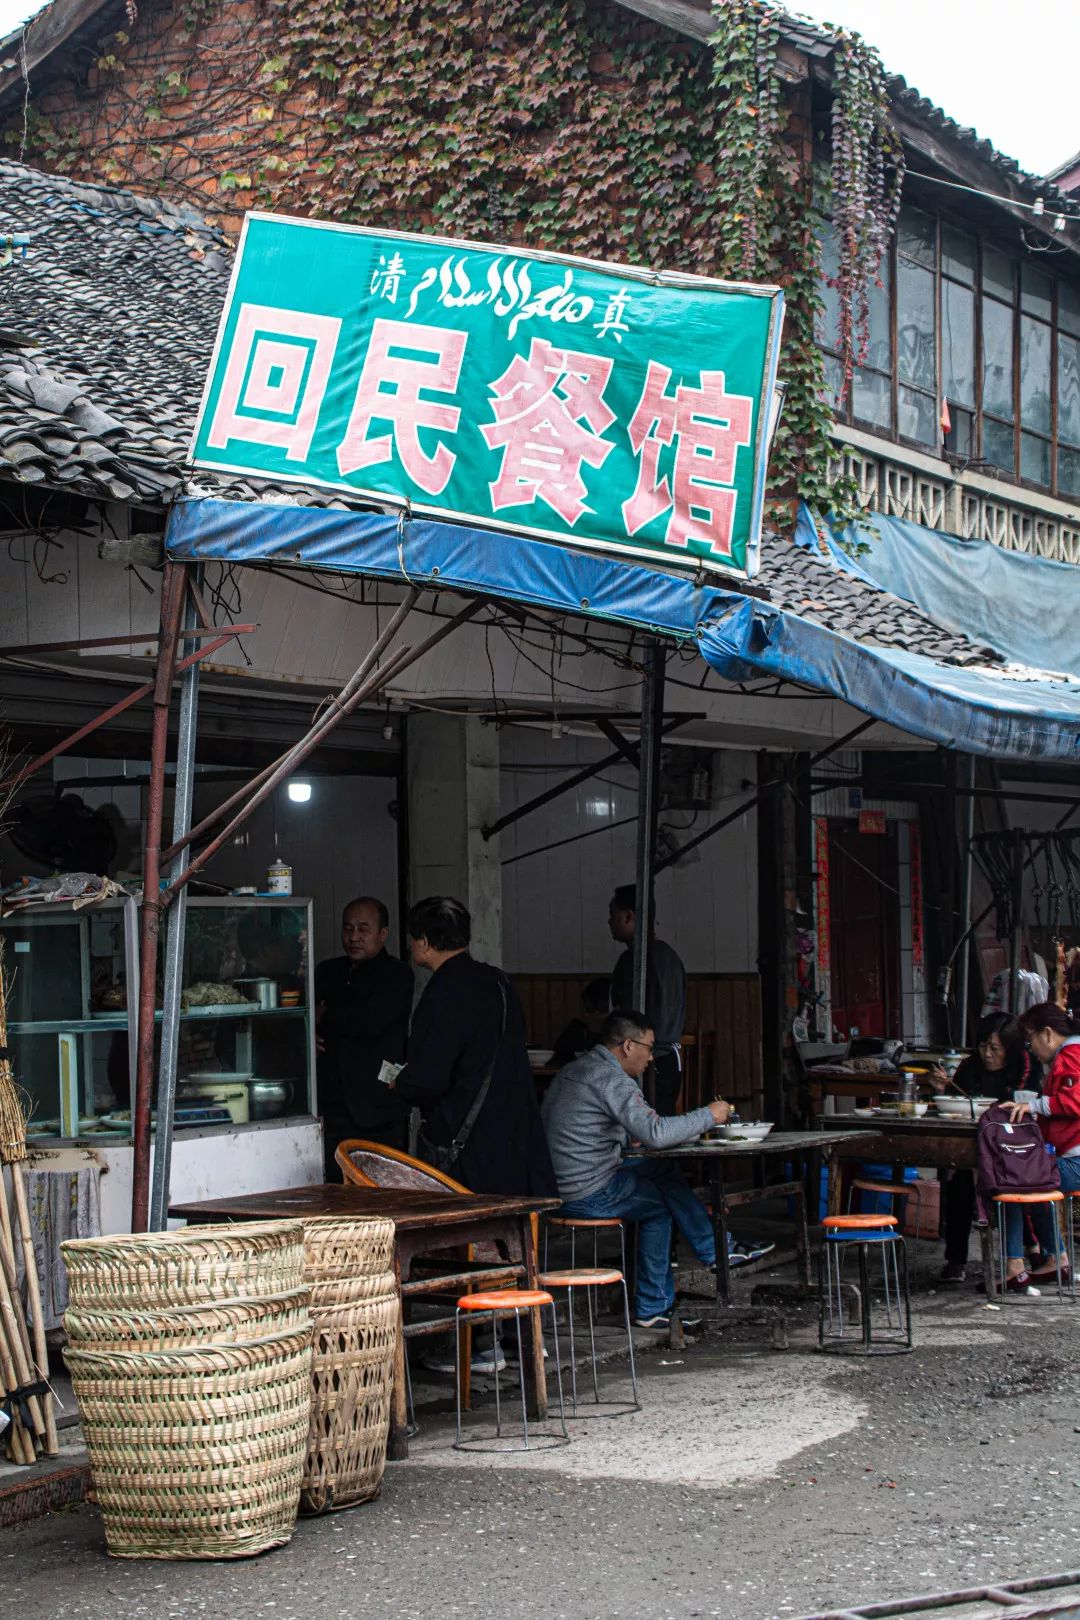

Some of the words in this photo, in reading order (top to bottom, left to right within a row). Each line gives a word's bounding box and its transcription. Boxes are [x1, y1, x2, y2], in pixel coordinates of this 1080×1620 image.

[370, 252, 407, 304] 清
[593, 287, 630, 344] 真
[206, 302, 754, 557] 回民餐馆
